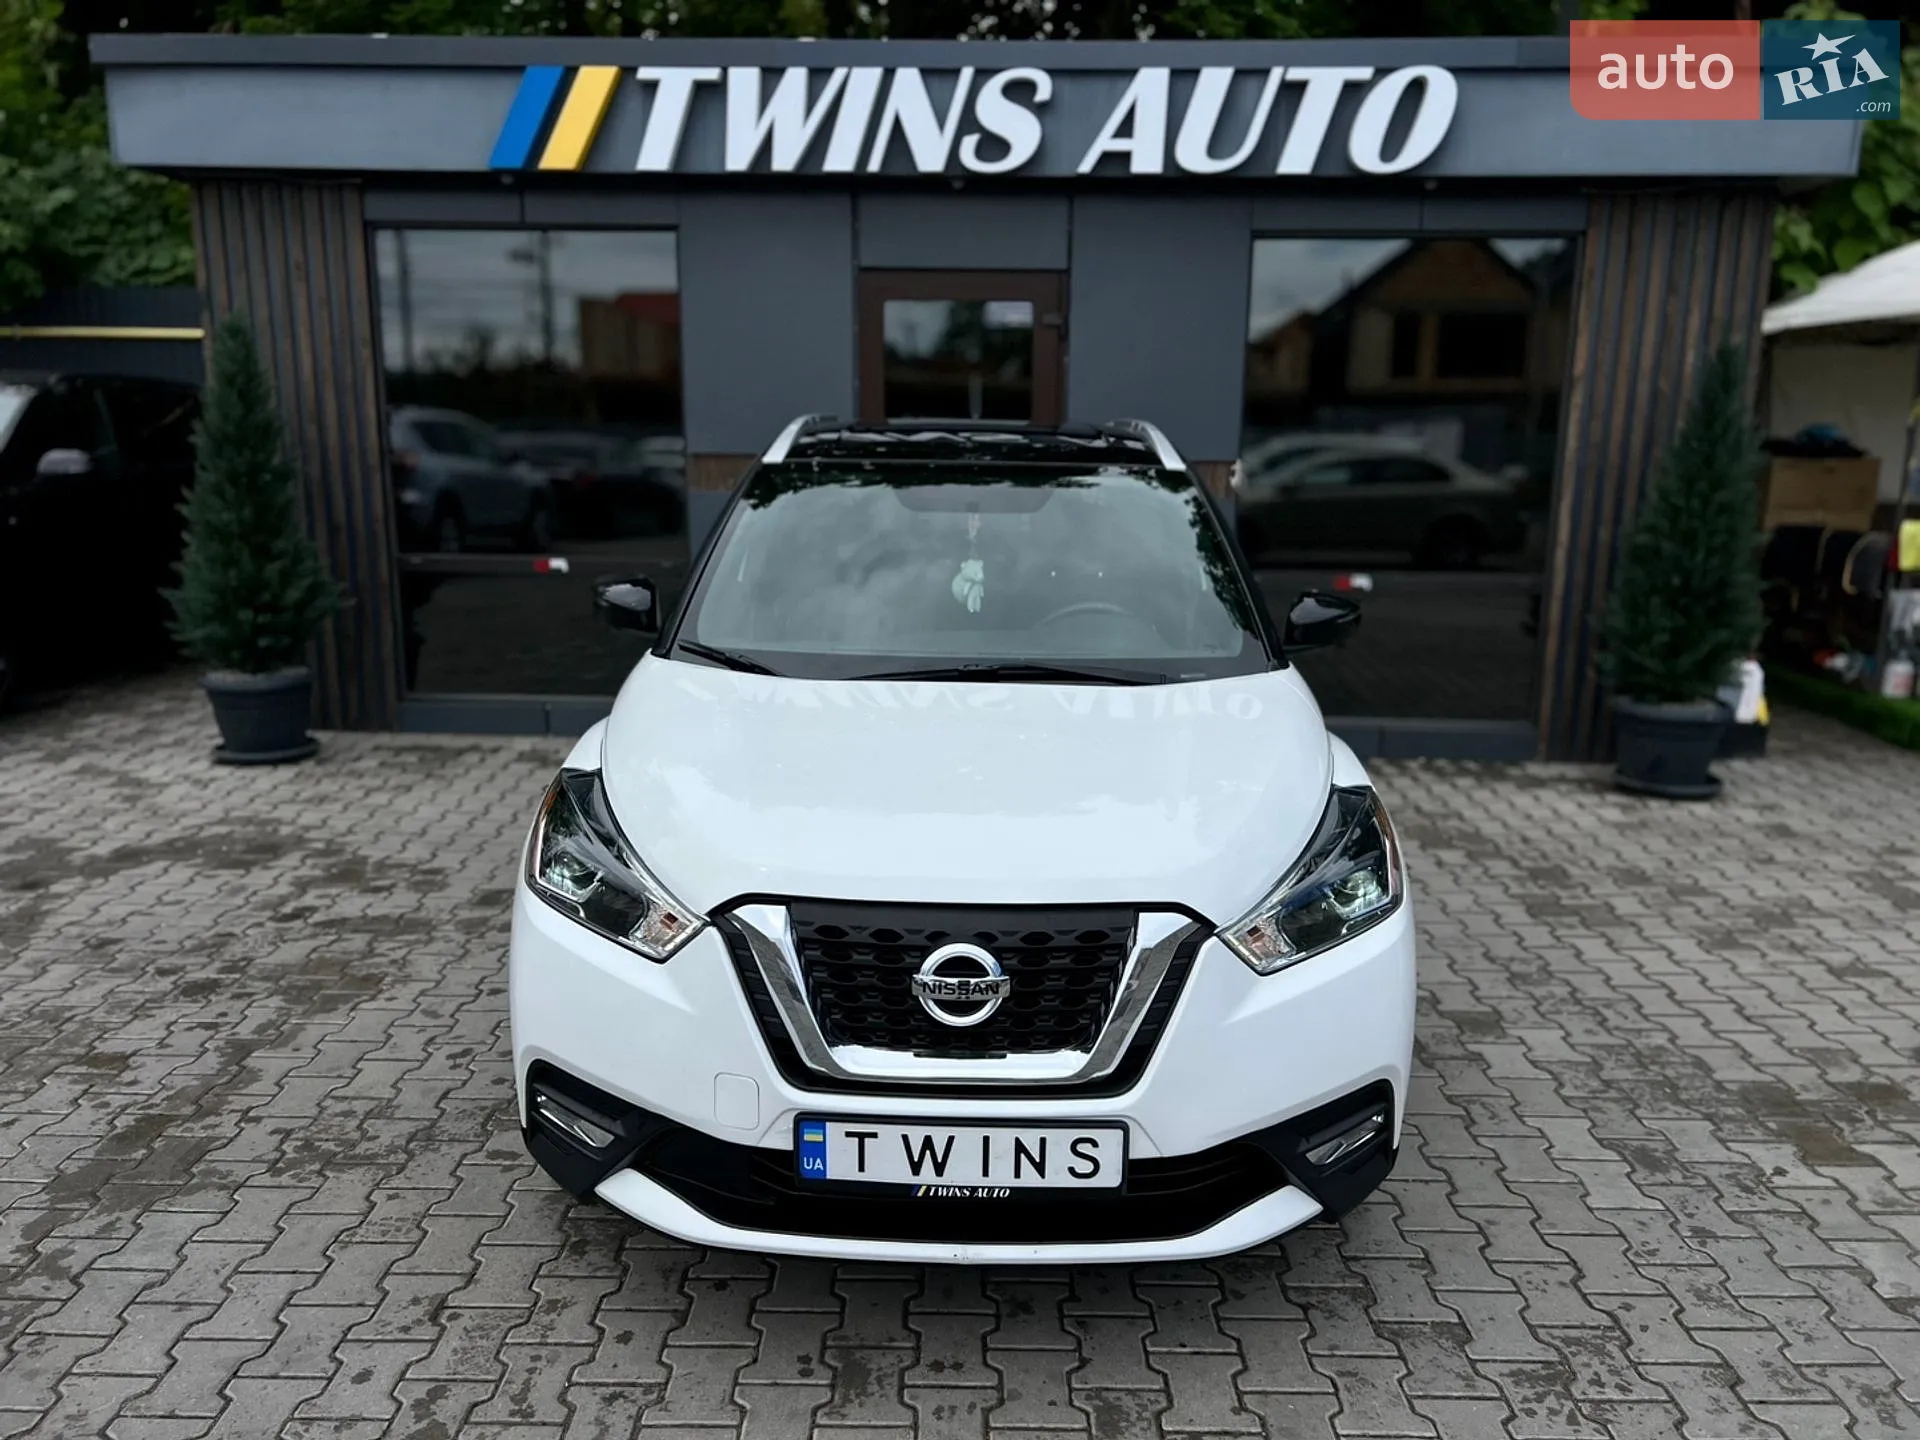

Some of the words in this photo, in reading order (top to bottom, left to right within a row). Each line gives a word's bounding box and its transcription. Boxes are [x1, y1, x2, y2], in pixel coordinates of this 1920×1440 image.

[636, 67, 1052, 174] TWINS
[1077, 66, 1459, 174] AUTO
[922, 981, 1000, 996] NISSAN
[803, 1157, 824, 1171] UA
[928, 1186, 972, 1198] TWINS
[975, 1187, 1011, 1198] AUTO
